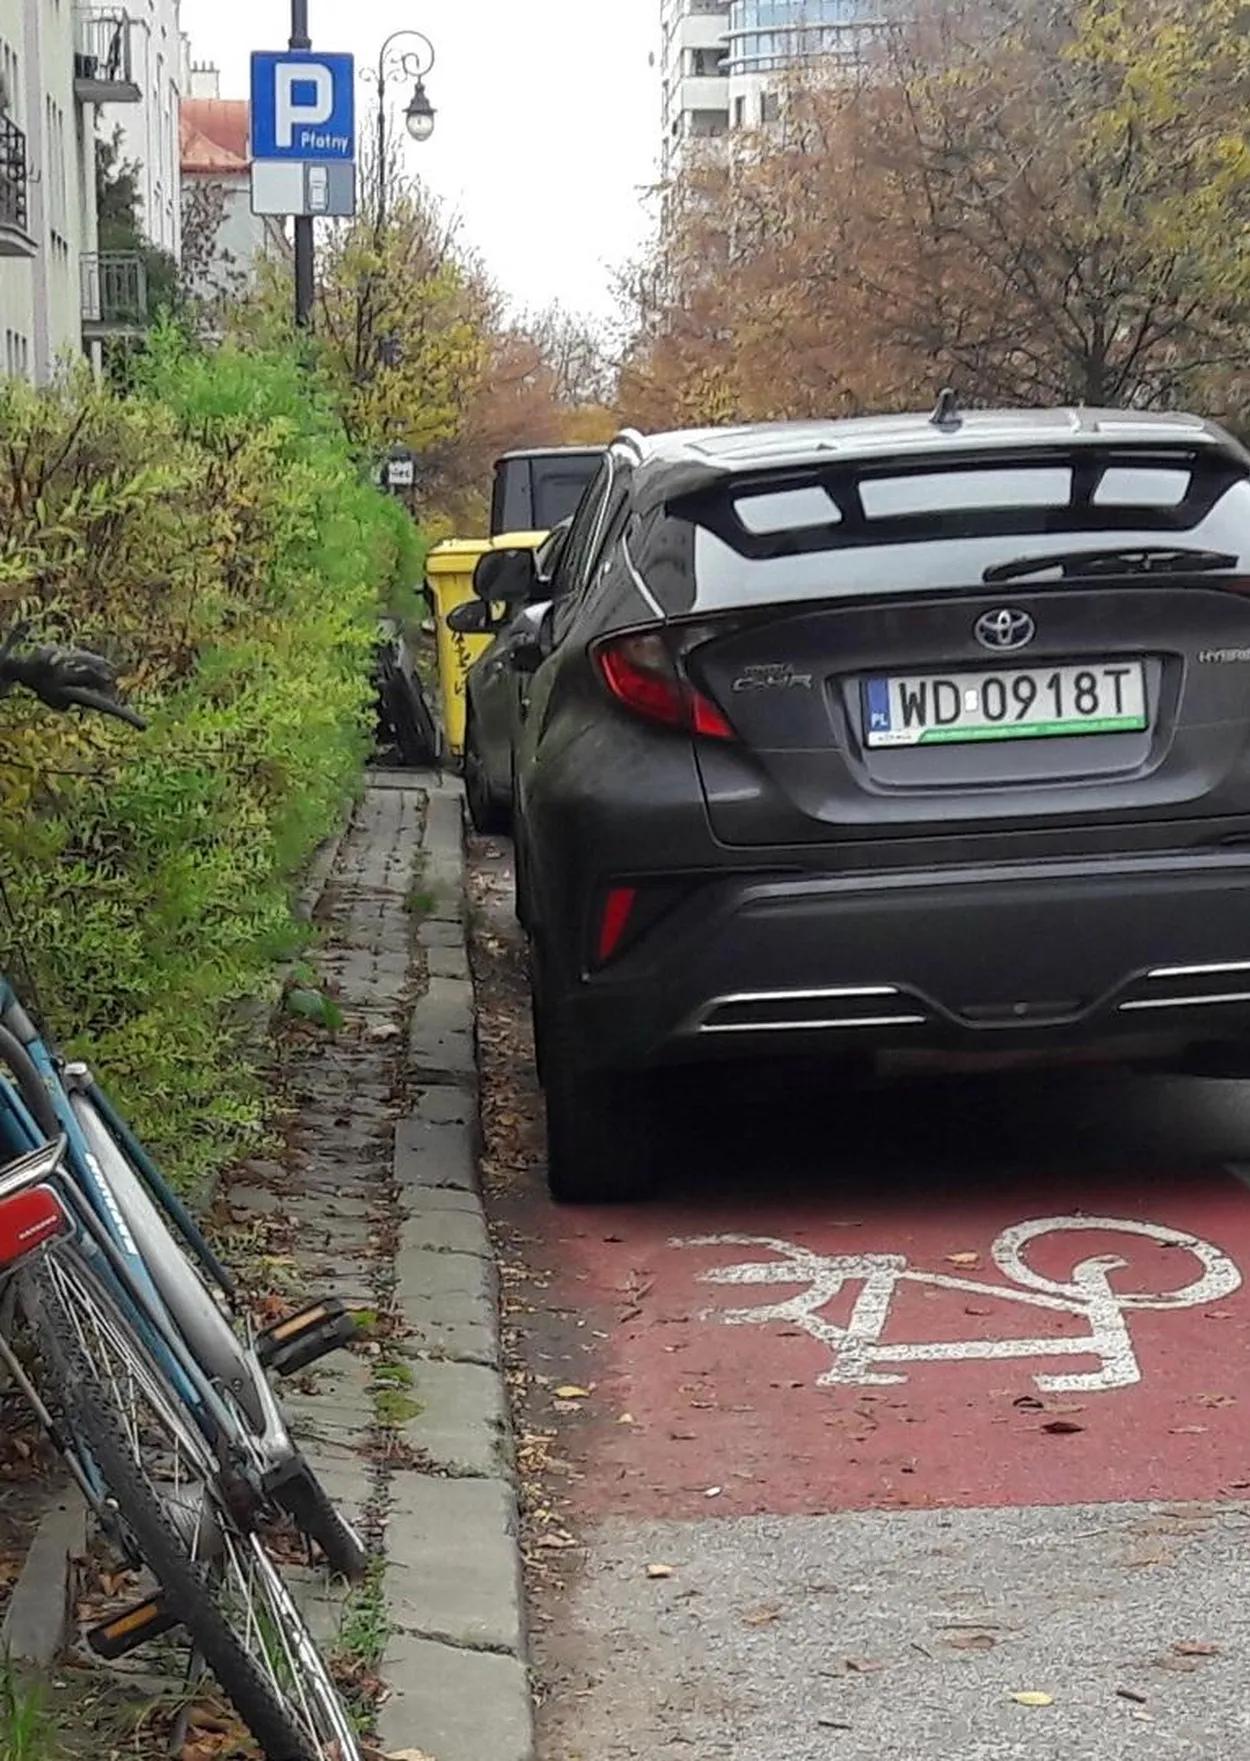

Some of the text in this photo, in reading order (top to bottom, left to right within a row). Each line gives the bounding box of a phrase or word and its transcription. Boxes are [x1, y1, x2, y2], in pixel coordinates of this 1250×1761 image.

[275, 63, 333, 147] P
[871, 712, 888, 727] PL
[898, 669, 1131, 727] WD 0918T
